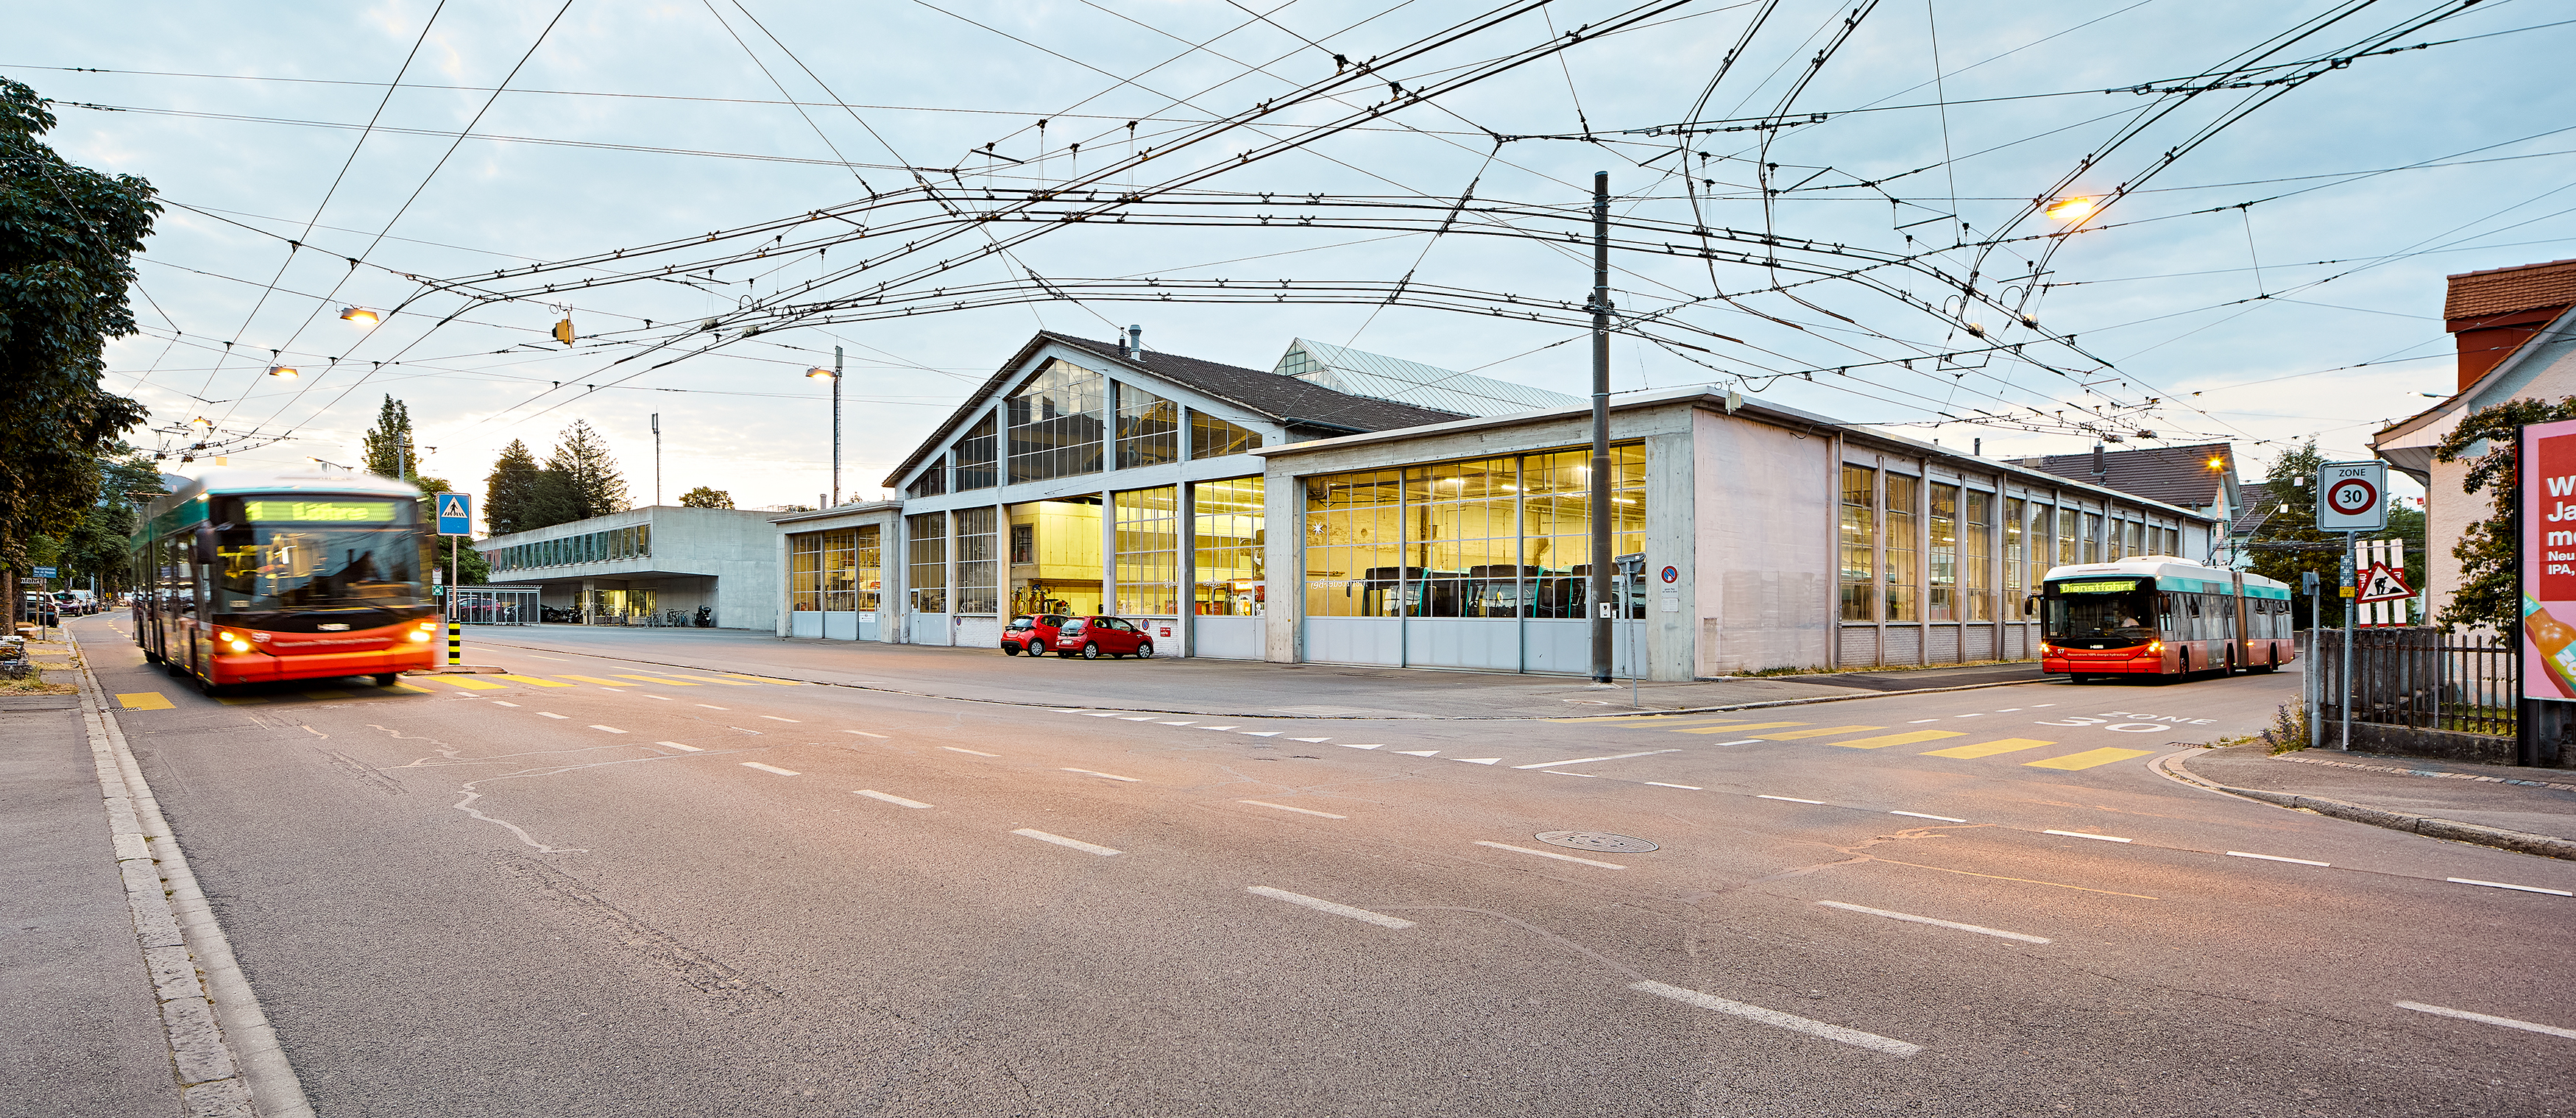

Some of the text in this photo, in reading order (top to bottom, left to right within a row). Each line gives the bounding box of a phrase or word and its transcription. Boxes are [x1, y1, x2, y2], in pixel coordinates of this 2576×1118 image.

[2339, 469, 2366, 477] ZONE
[2343, 489, 2362, 503] 30
[2548, 530, 2576, 546] m
[2548, 551, 2575, 562] Neu
[2548, 564, 2575, 576] IPA,
[2063, 582, 2134, 592] Dienstfahrt
[2034, 716, 2171, 733] 30
[2098, 711, 2218, 726] ZONE
